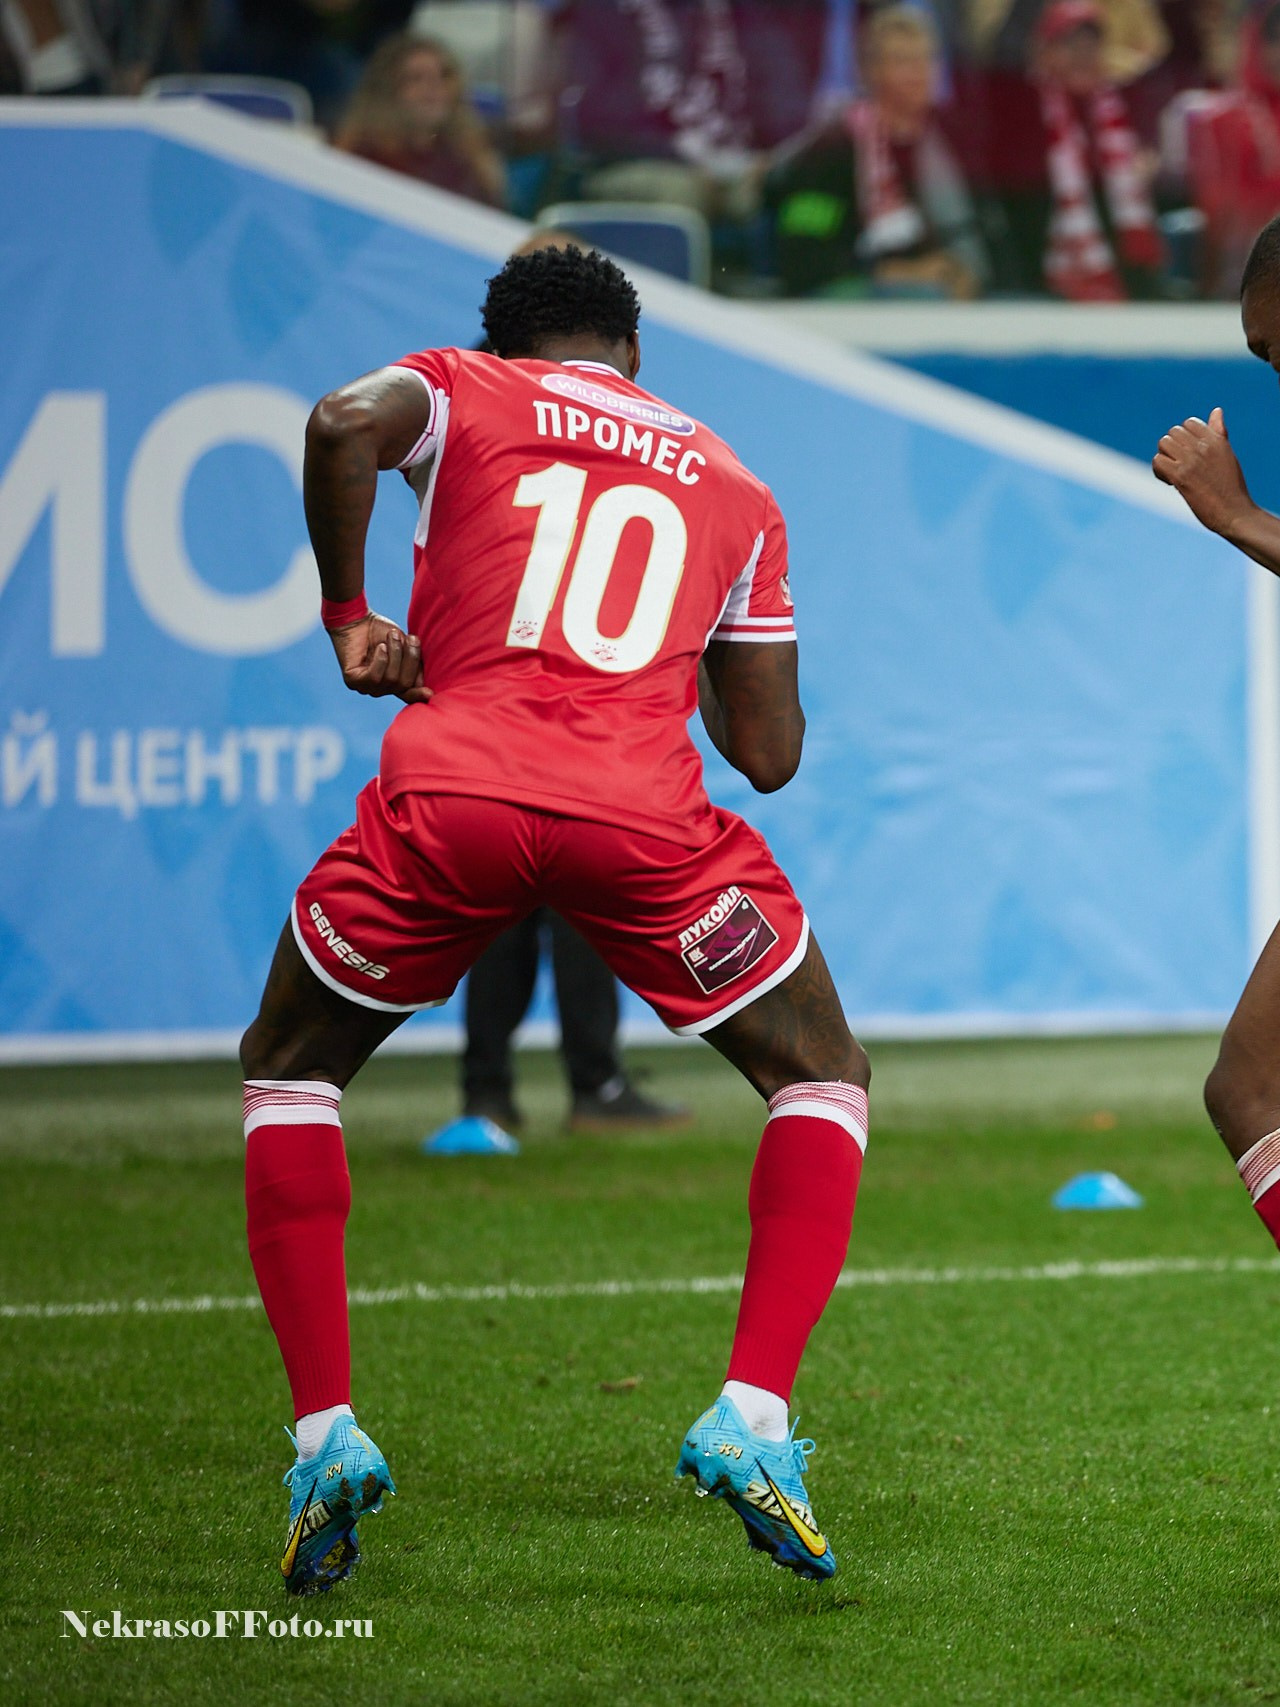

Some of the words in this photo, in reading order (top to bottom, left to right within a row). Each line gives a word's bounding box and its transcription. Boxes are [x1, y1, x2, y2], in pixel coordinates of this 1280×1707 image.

[532, 399, 707, 486] ПРОМЕС
[556, 378, 684, 428] WILDBERRIES
[505, 461, 687, 673] 10
[75, 726, 345, 821] ЦЕНТР
[309, 901, 391, 980] GENESIS
[678, 885, 742, 949] ЛУКОЙЛ
